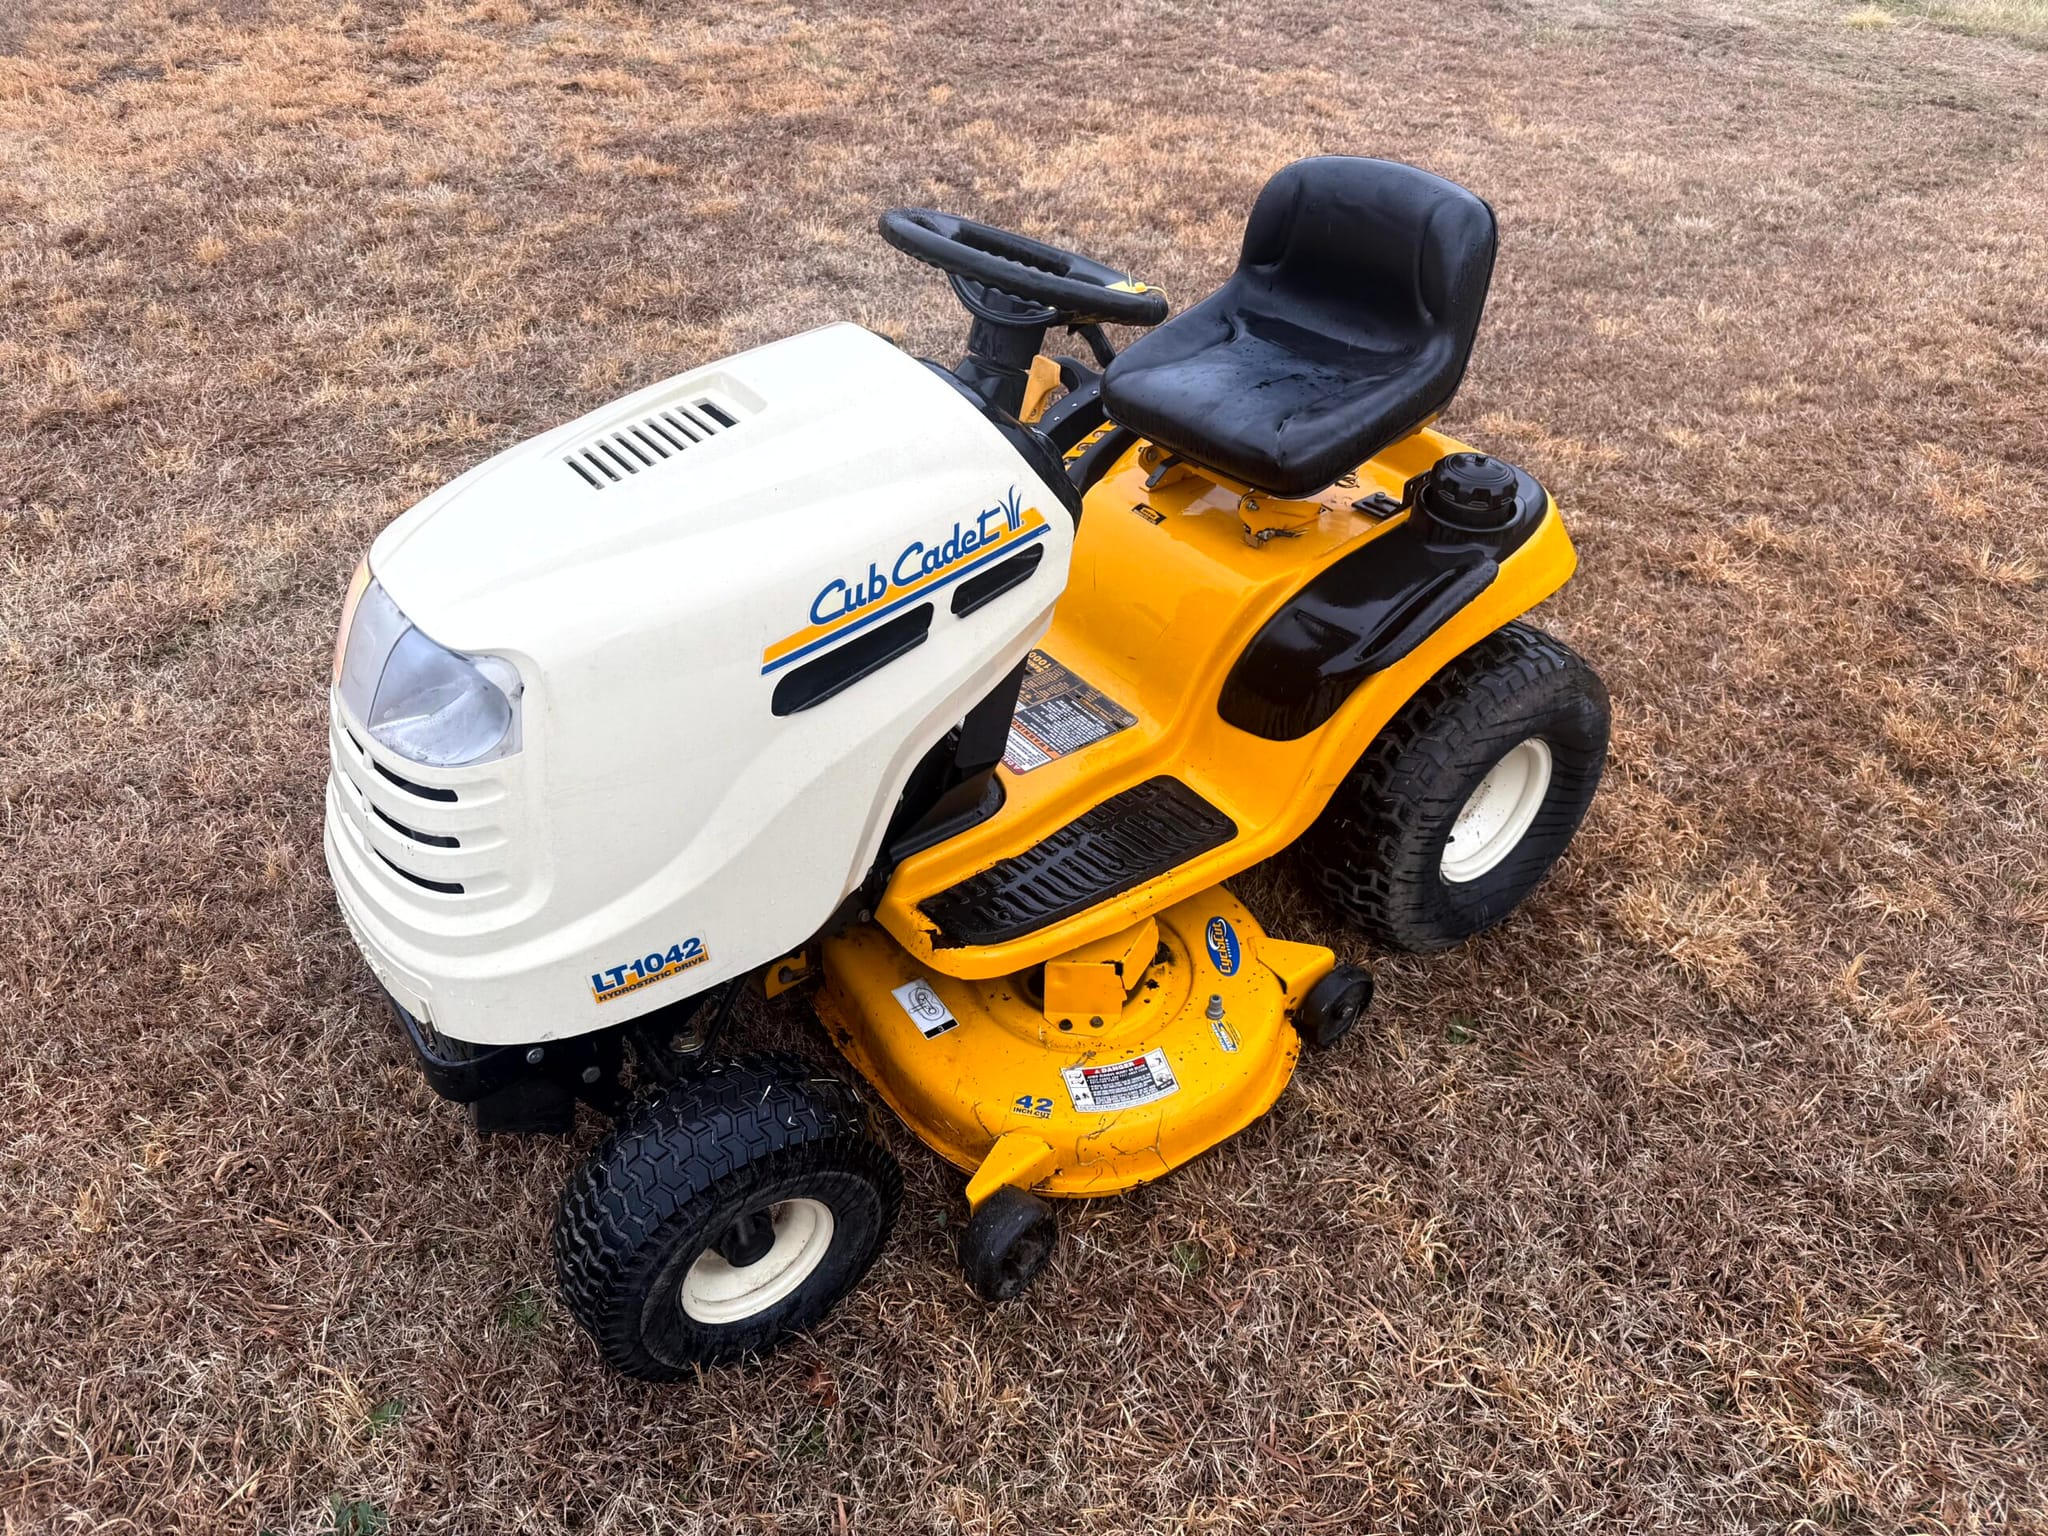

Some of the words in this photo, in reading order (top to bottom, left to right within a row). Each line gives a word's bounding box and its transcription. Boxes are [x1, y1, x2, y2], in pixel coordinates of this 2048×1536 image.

[809, 563, 887, 625] Cub
[892, 506, 1000, 586] Cadet
[592, 937, 703, 993] LT1042
[598, 969, 672, 1002] HYDROSTATIC
[674, 956, 705, 973] DRIVE
[1101, 1061, 1135, 1073] DANGER
[1013, 1107, 1033, 1115] INCH
[1033, 1110, 1051, 1119] CUT
[1015, 1095, 1053, 1112] 42
